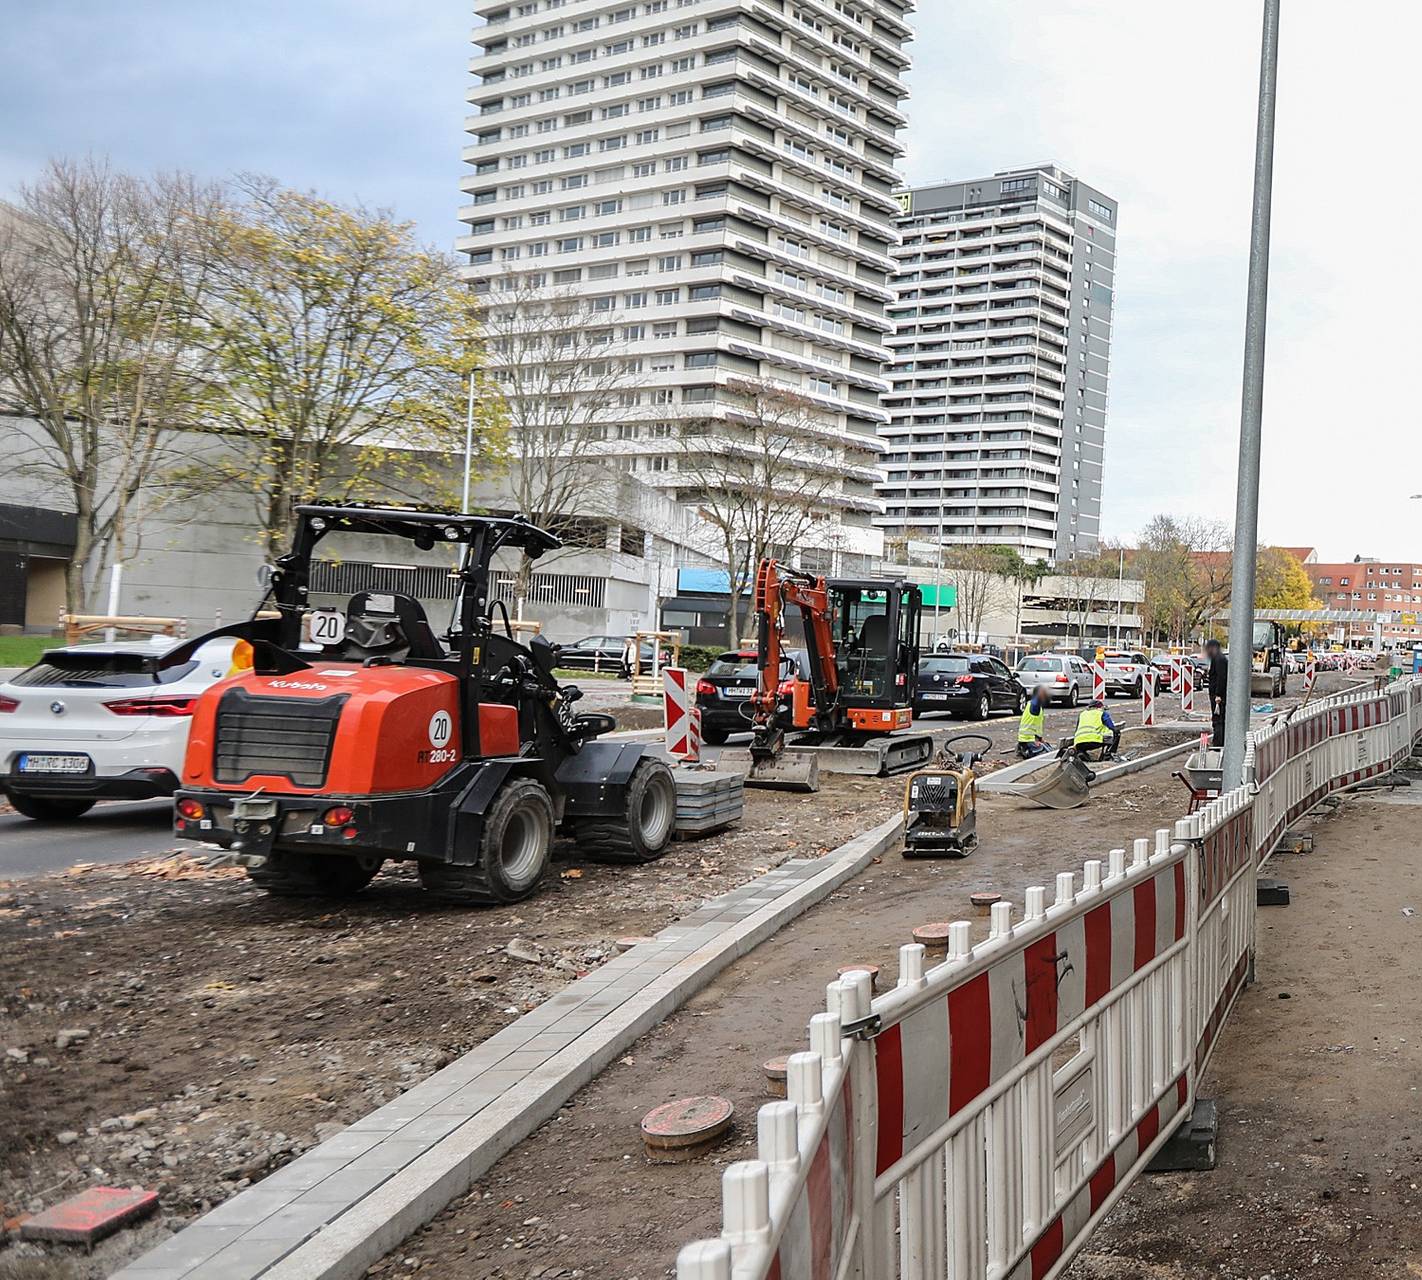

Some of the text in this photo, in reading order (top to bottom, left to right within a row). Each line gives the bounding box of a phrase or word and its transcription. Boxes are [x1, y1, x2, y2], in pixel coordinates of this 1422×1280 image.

[315, 615, 338, 638] 20
[267, 680, 328, 691] Kubota
[433, 718, 447, 740] 20
